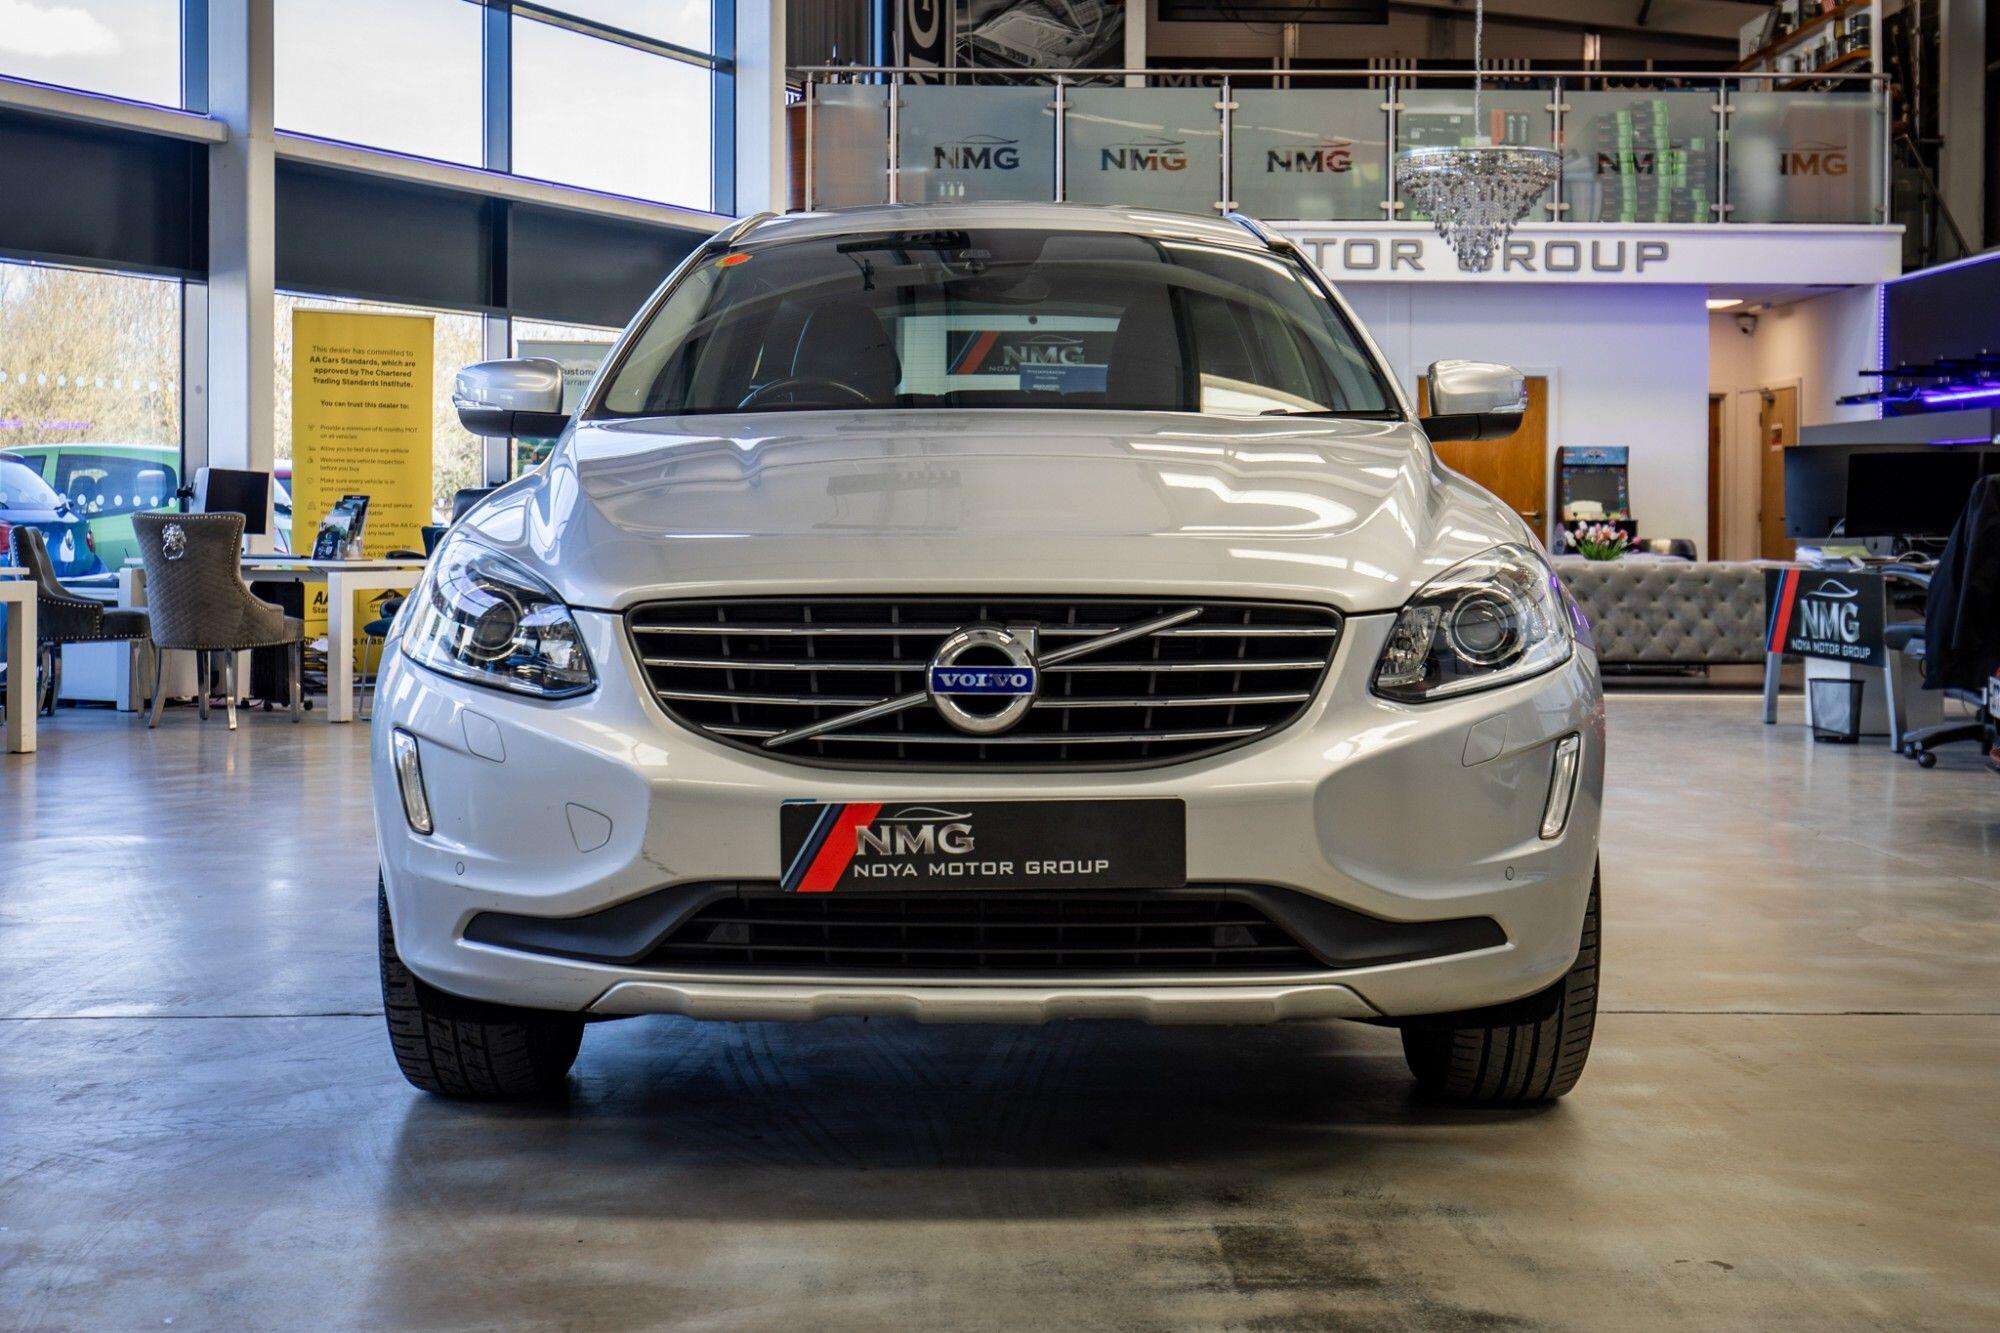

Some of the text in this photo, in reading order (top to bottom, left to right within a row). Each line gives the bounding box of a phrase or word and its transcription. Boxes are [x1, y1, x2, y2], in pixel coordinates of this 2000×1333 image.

[934, 147, 1020, 170] NMG
[1101, 148, 1187, 171] NMG
[1267, 150, 1352, 173] NMG
[1289, 238, 1425, 271] TOR
[312, 345, 329, 353] This
[329, 346, 351, 354] dealer
[353, 347, 365, 355] has
[367, 348, 404, 356] committed
[1003, 345, 1085, 365] NMG
[322, 356, 339, 364] Cars
[341, 358, 380, 366] Standards,
[381, 359, 403, 367] which
[314, 367, 348, 376] approved
[350, 367, 359, 376] by
[375, 369, 412, 377] Chartered
[313, 377, 413, 388] Trading Standards Institute.
[1801, 599, 1860, 643] NMG
[1792, 639, 1871, 659] NOYA MOTOR GROUP
[938, 673, 1028, 687] VOLVO
[854, 823, 975, 856] NMG
[854, 859, 1109, 878] NOYA MOTOR GROUP
